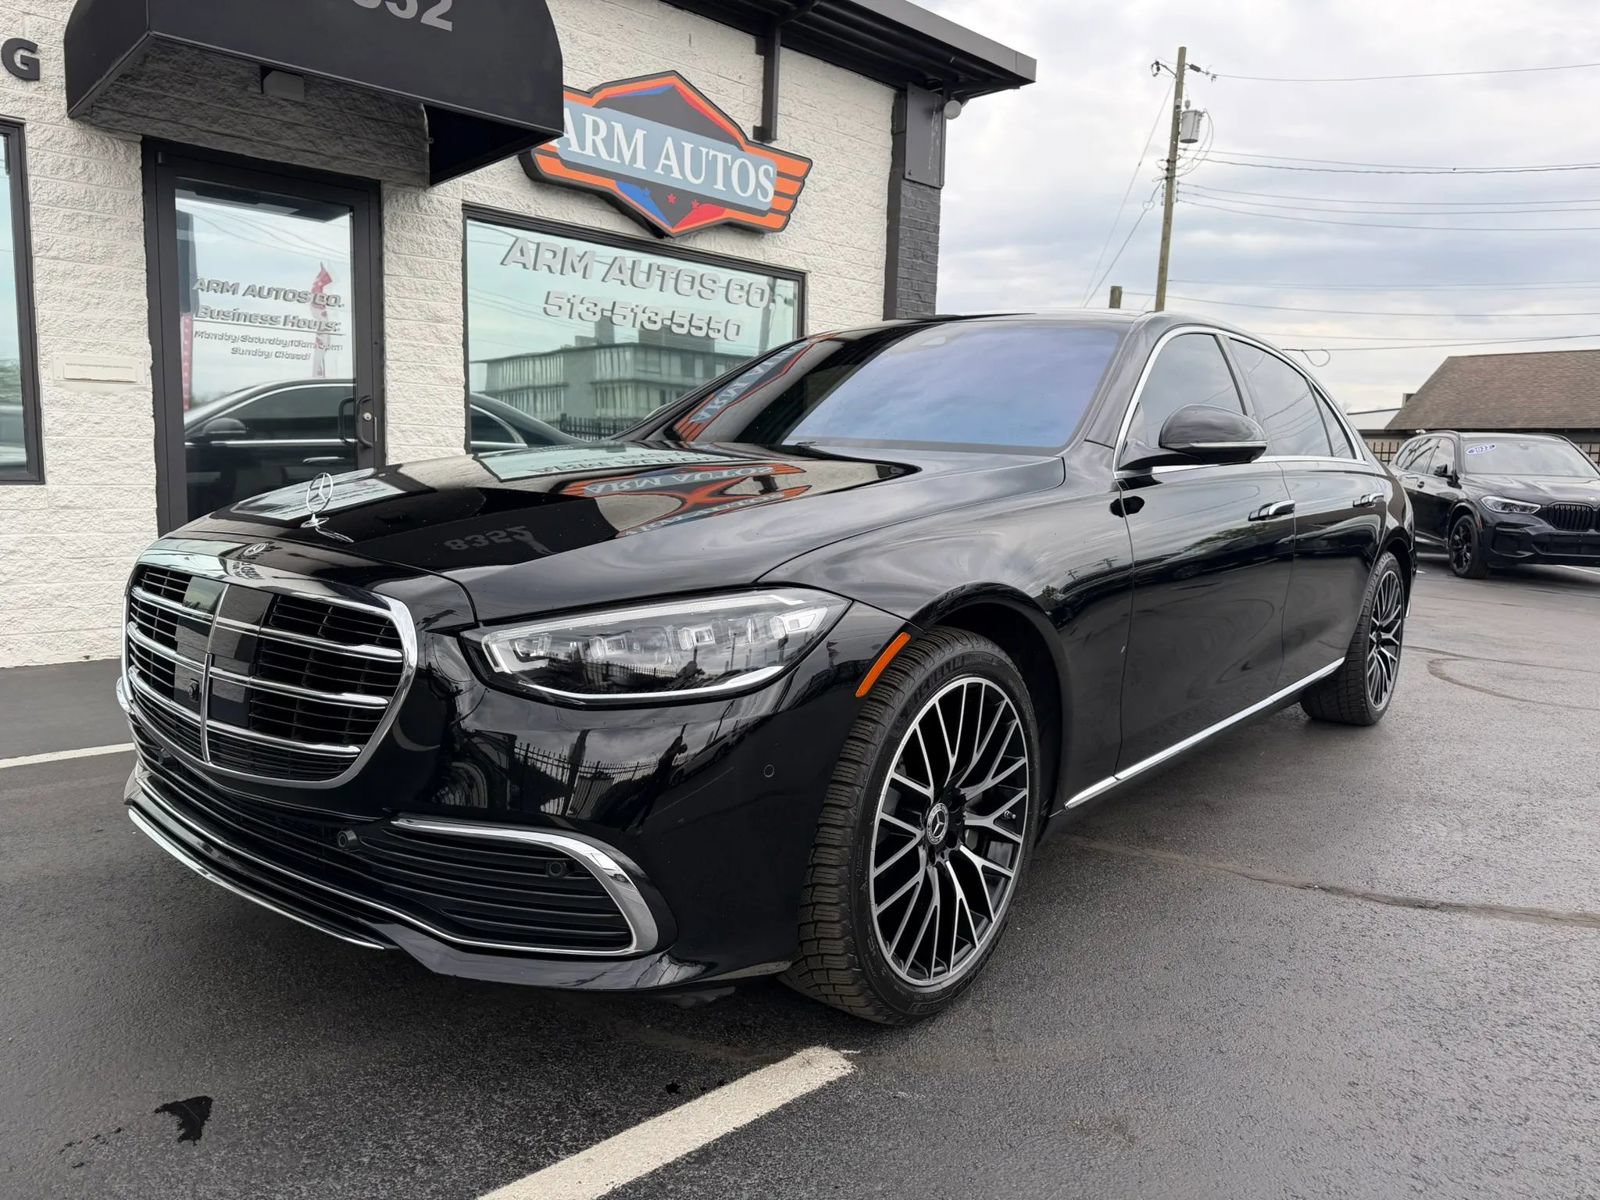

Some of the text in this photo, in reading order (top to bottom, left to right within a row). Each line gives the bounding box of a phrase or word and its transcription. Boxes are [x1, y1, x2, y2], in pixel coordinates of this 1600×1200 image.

[1, 38, 40, 81] G
[549, 107, 775, 203] ARM AUTOS
[193, 278, 240, 296] ARM
[242, 284, 311, 304] AUTOS
[501, 236, 596, 280] ARM
[602, 256, 720, 301] AUTOS
[194, 304, 281, 327] Business
[543, 290, 742, 342] 513-513-5550
